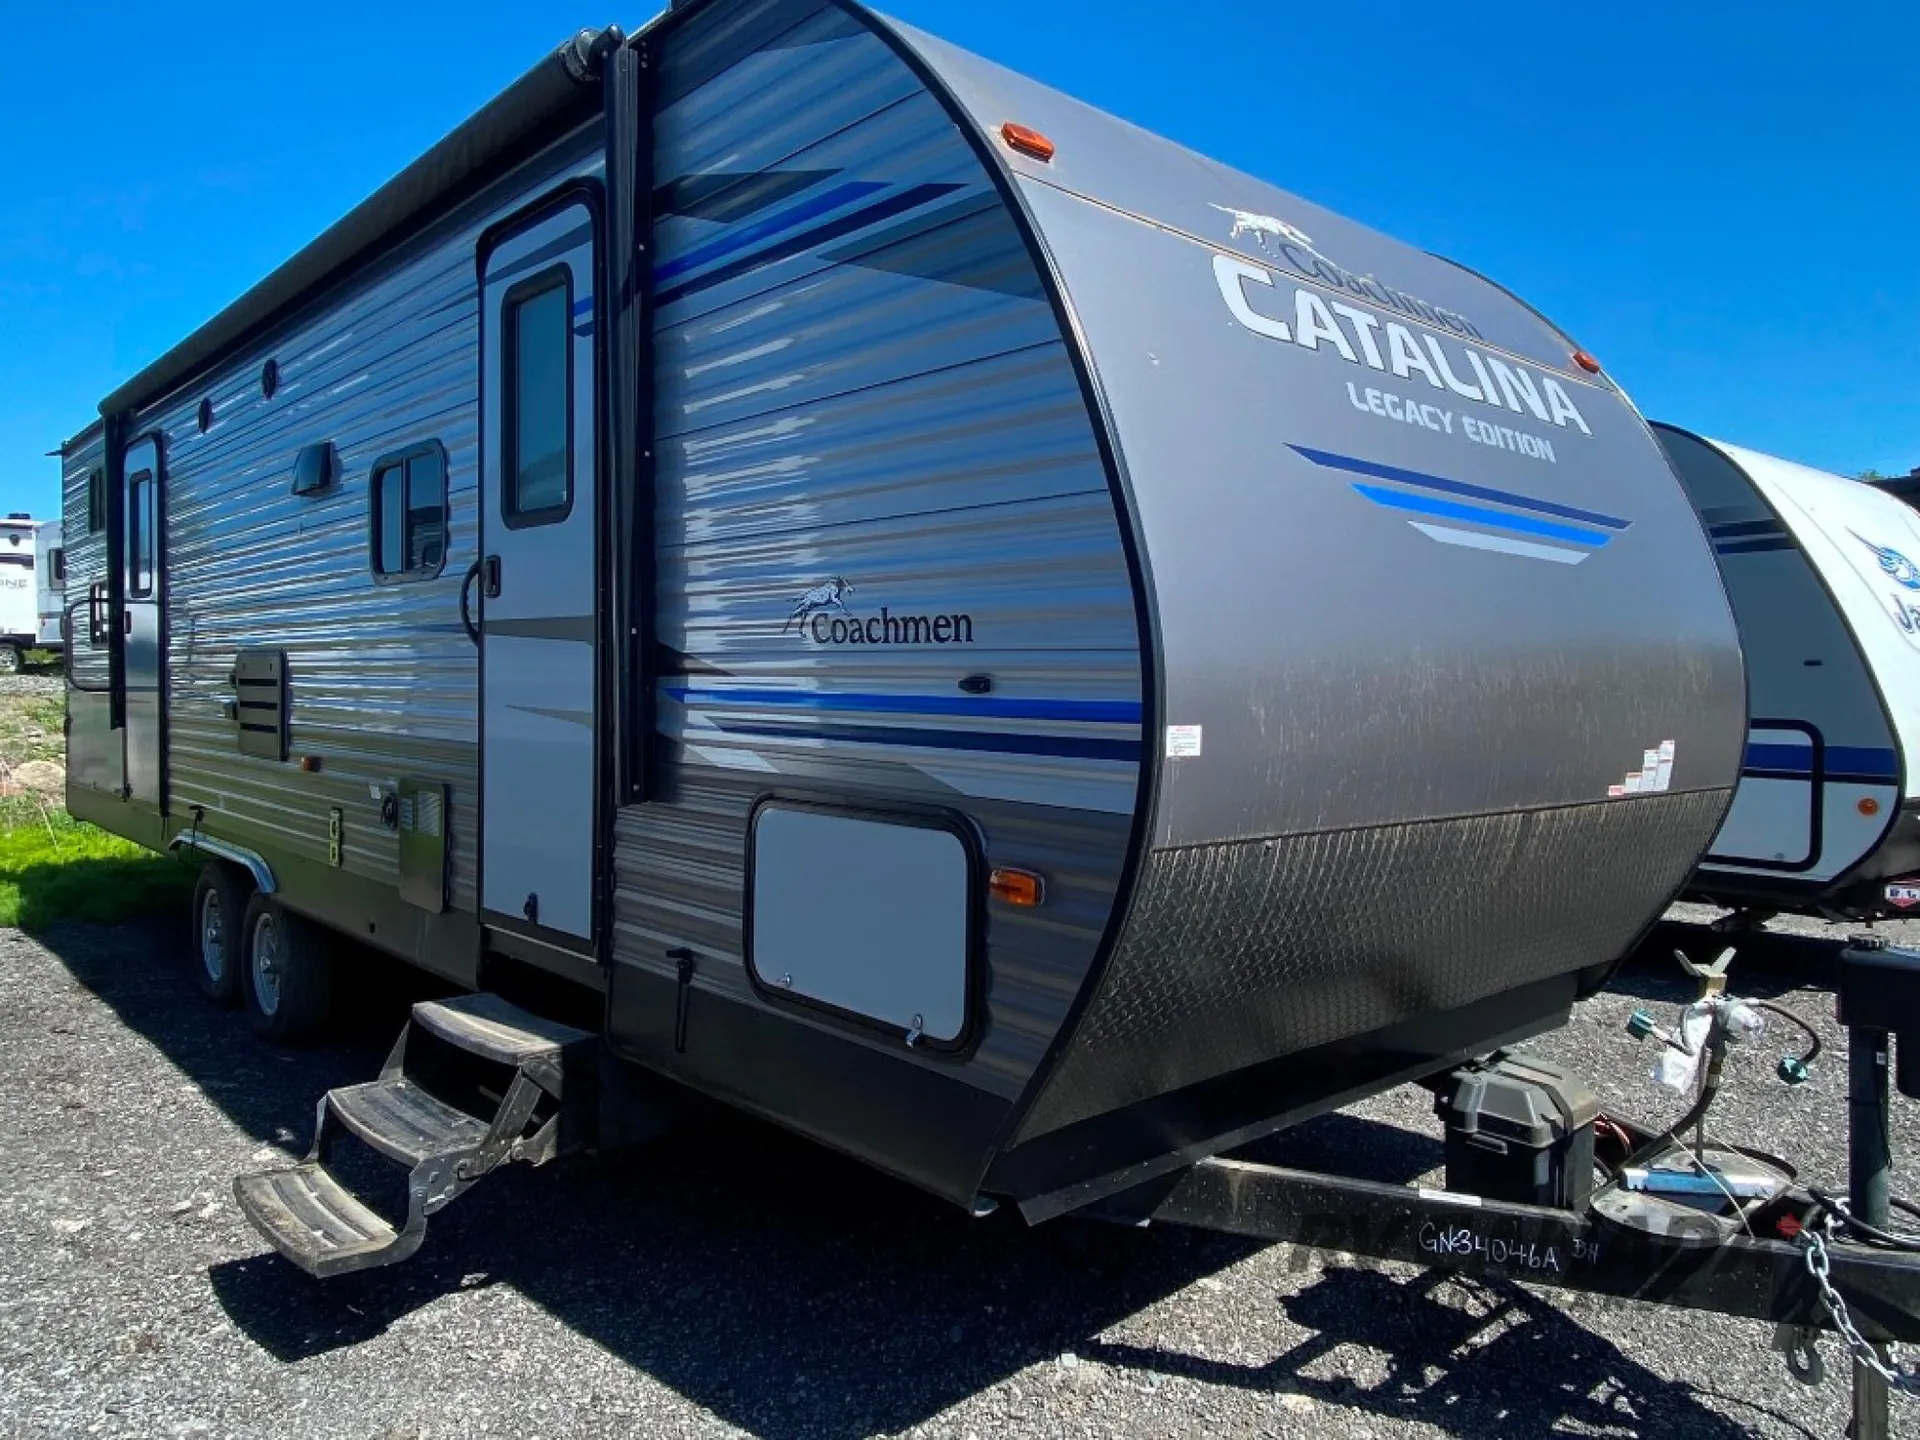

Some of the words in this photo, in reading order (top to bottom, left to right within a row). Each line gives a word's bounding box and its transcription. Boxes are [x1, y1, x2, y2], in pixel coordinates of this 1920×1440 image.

[1279, 241, 1484, 341] Coachmen
[1212, 252, 1594, 438] CATALINA
[1346, 380, 1454, 434] LEGACY
[1462, 415, 1557, 463] EDITION
[811, 607, 974, 644] Coachmen
